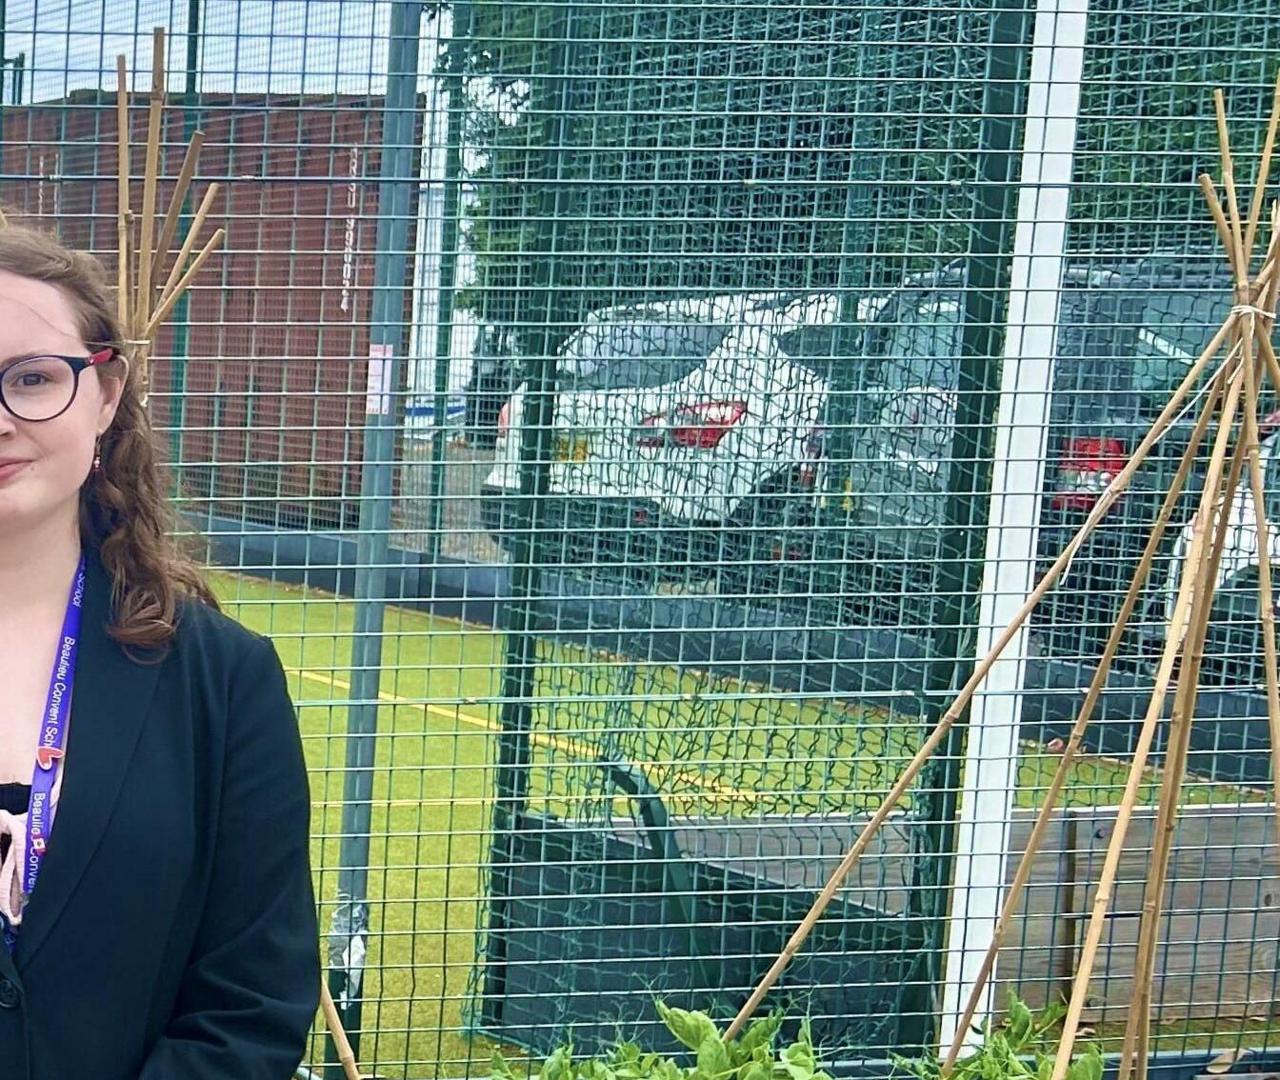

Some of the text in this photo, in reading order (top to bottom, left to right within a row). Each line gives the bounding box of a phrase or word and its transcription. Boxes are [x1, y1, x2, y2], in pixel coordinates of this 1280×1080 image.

[57, 636, 76, 681] Beaulieu
[47, 682, 66, 724] Convent
[31, 792, 46, 838] Beaulie
